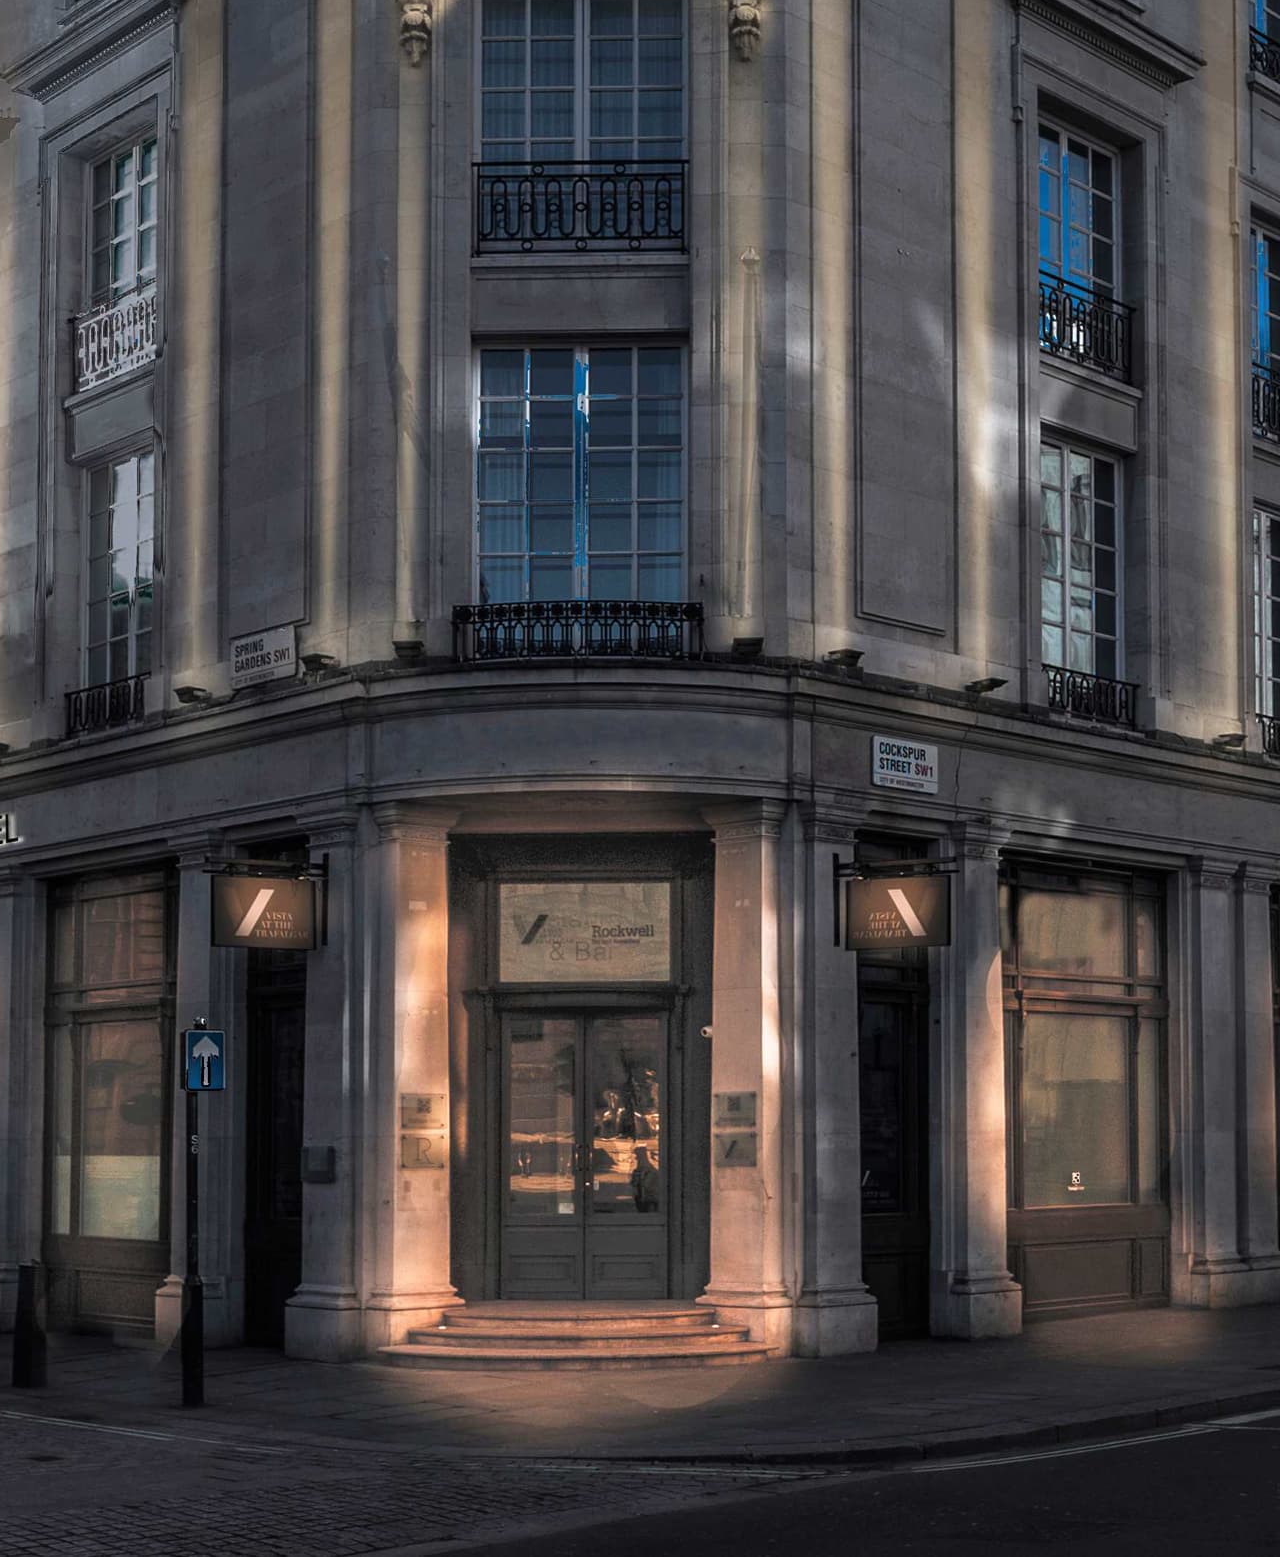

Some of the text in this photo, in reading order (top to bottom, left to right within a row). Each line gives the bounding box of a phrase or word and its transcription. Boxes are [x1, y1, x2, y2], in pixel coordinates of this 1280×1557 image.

[235, 639, 264, 658] SPRING
[235, 648, 290, 673] GARDENS SW1
[880, 742, 926, 761] COCKSPUR
[880, 757, 933, 778] STREET SW1
[265, 912, 294, 921] VISTA
[261, 921, 295, 930] AT THE
[591, 924, 655, 938] Rockwell
[255, 930, 309, 939] TRAFALGAR
